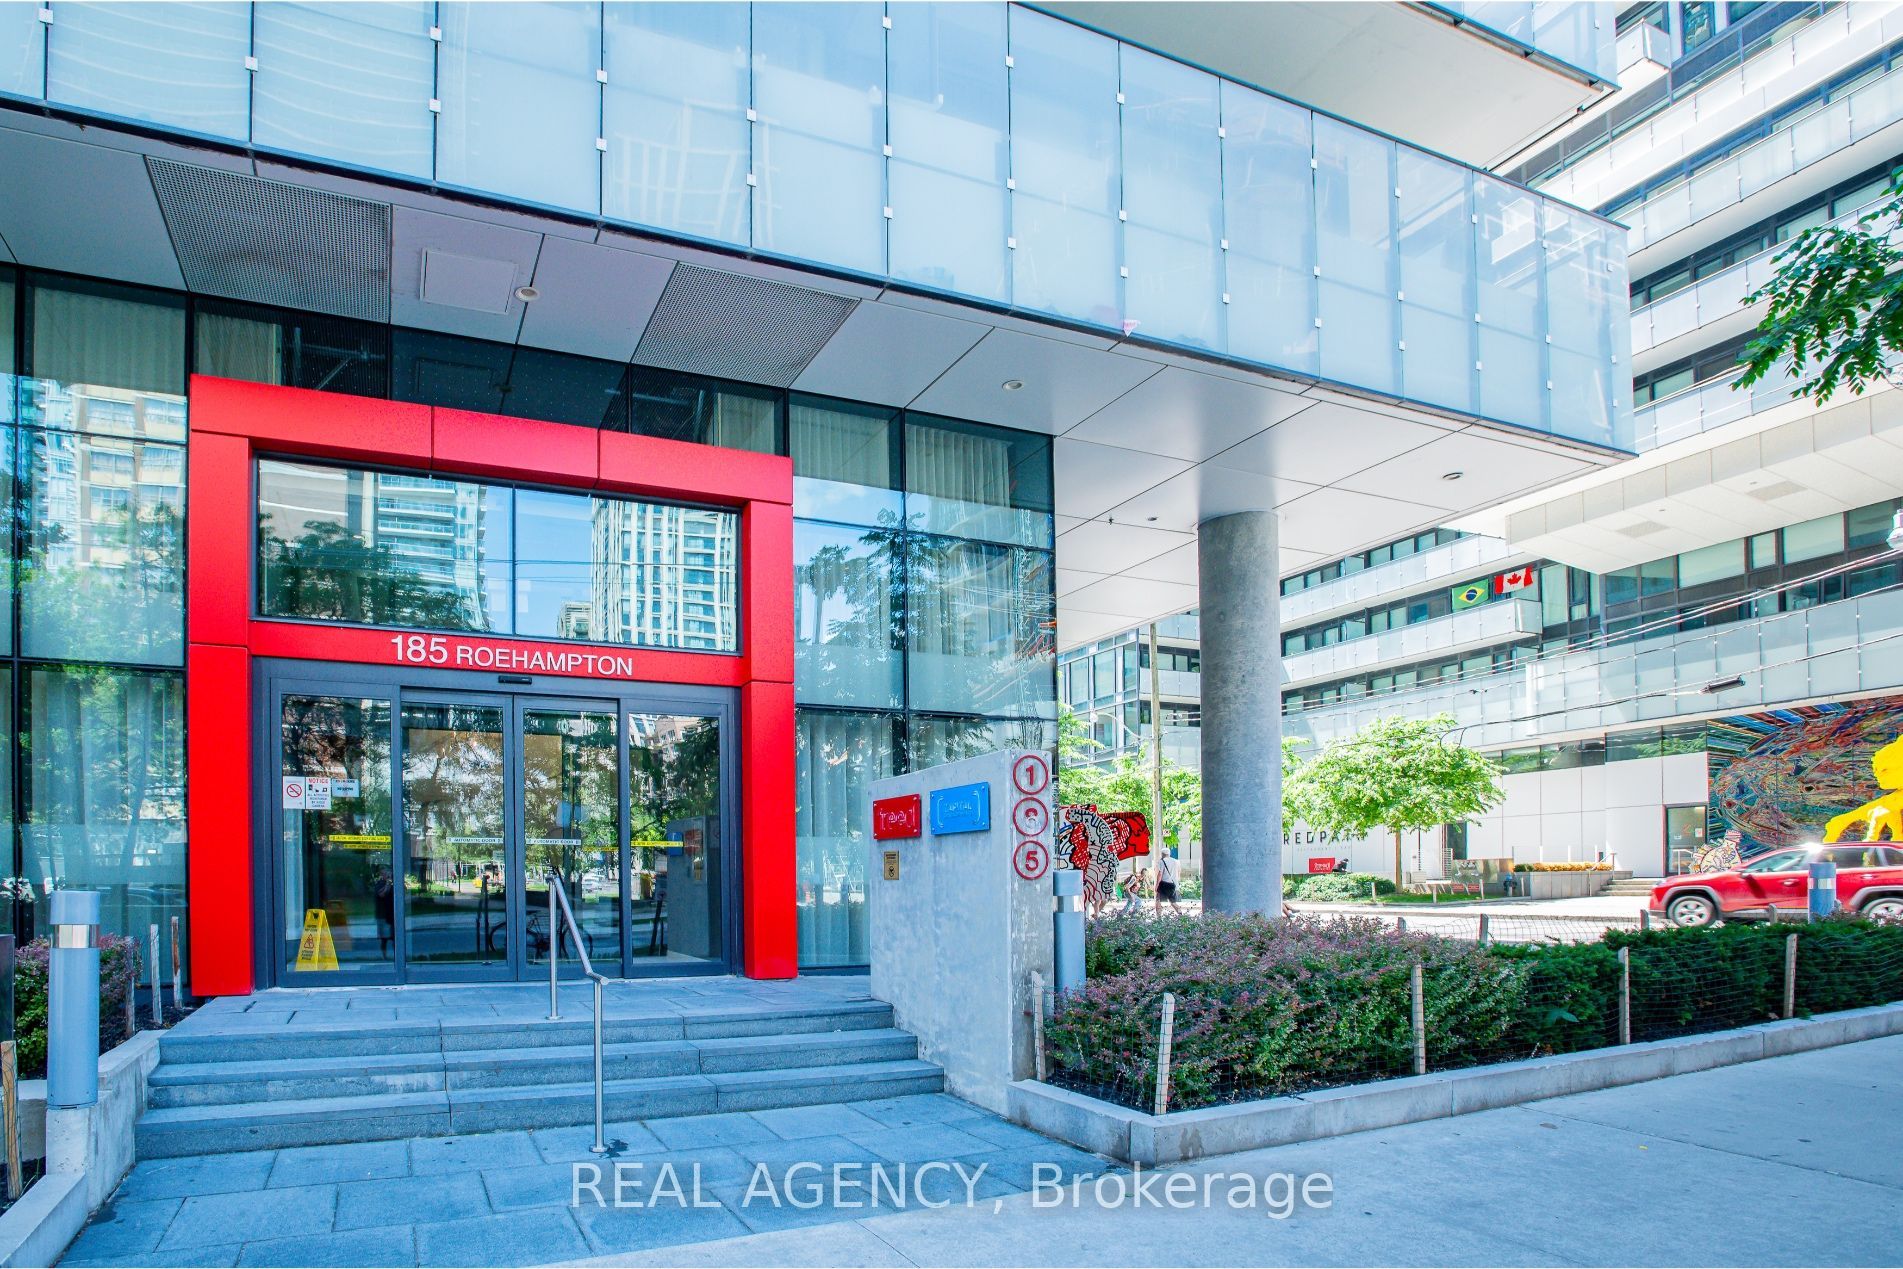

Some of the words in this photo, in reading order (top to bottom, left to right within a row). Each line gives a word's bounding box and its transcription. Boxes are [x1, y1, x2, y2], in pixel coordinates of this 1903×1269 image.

[391, 634, 448, 664] 185
[456, 645, 633, 676] ROEHAMPTON
[1283, 829, 1367, 845] REDPA
